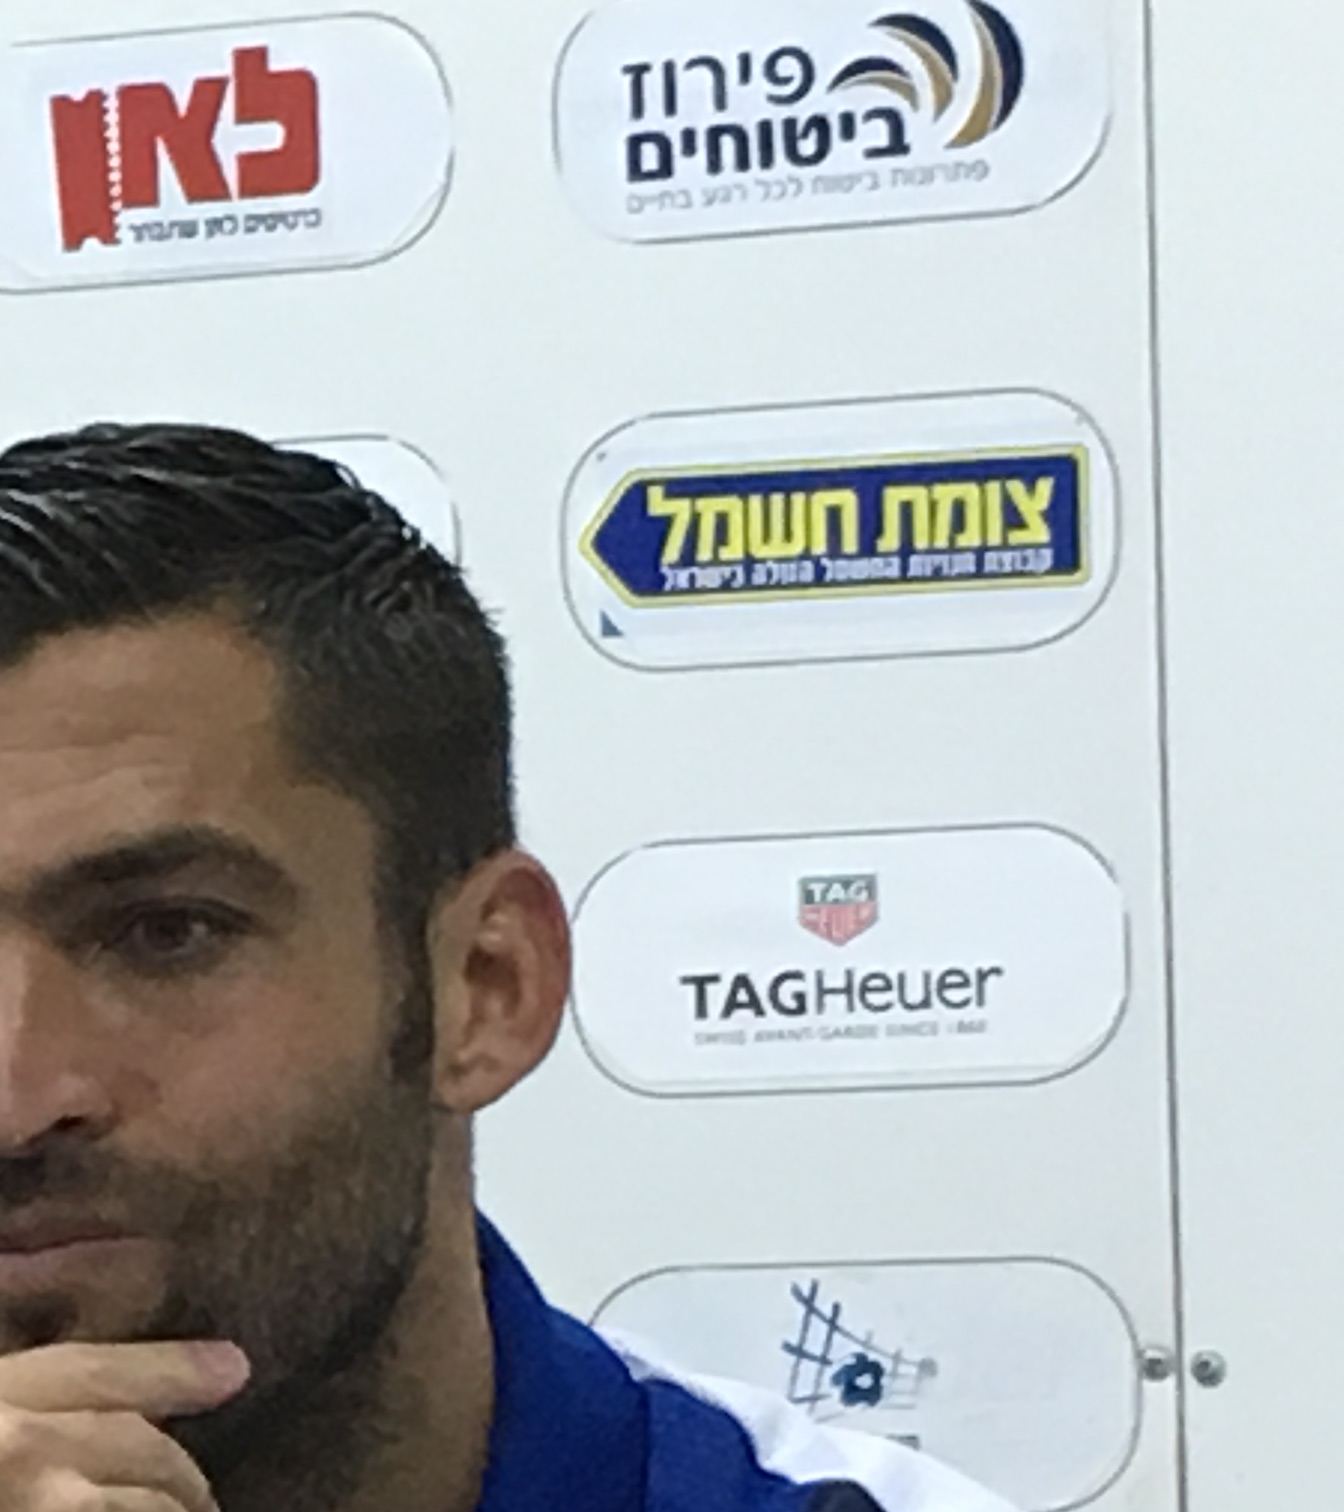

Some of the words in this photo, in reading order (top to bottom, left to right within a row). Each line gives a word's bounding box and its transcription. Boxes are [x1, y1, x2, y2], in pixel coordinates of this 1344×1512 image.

[621, 46, 818, 120] פירוז
[50, 45, 321, 253] לאן
[626, 107, 911, 183] ביטוחים
[646, 485, 858, 563] חשמל
[877, 476, 1056, 553] צומת
[808, 880, 869, 903] TAG
